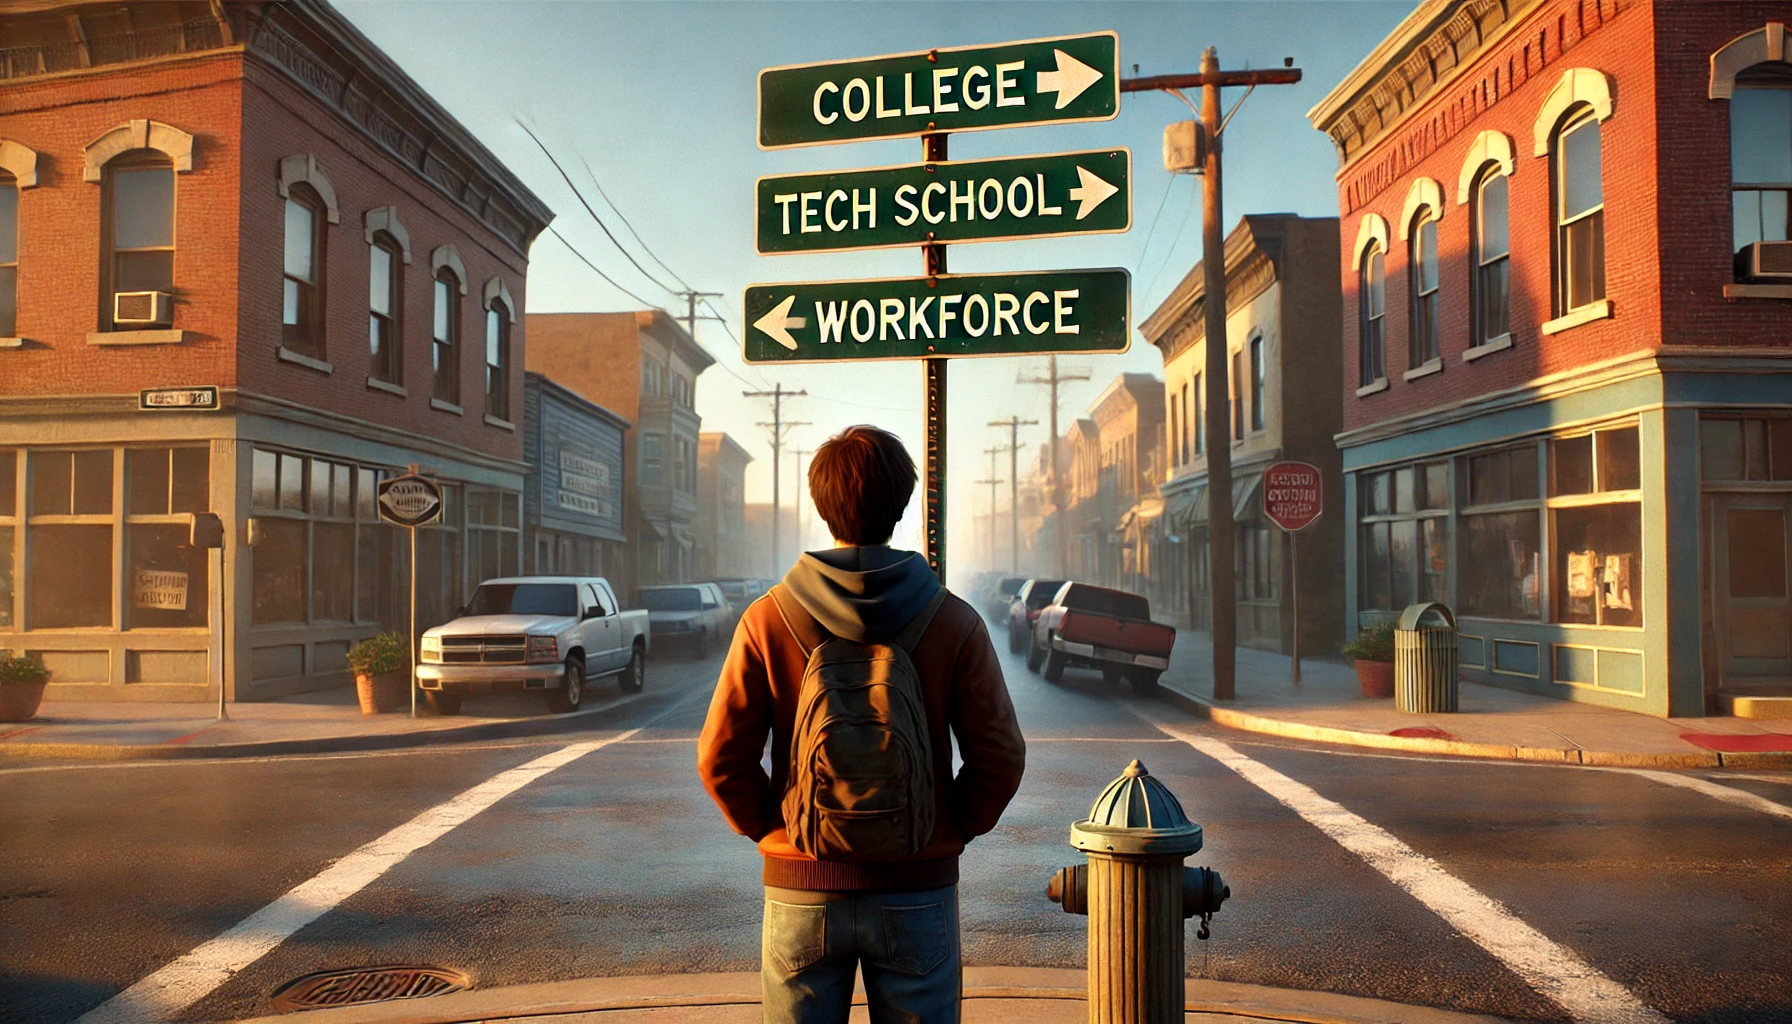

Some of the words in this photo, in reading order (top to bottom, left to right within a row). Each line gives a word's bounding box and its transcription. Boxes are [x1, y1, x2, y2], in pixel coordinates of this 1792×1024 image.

[812, 60, 1026, 126] COLLEGE
[774, 187, 876, 235] TECH
[894, 173, 1062, 227] SCHOOL
[814, 288, 1080, 344] WORKFORCE
